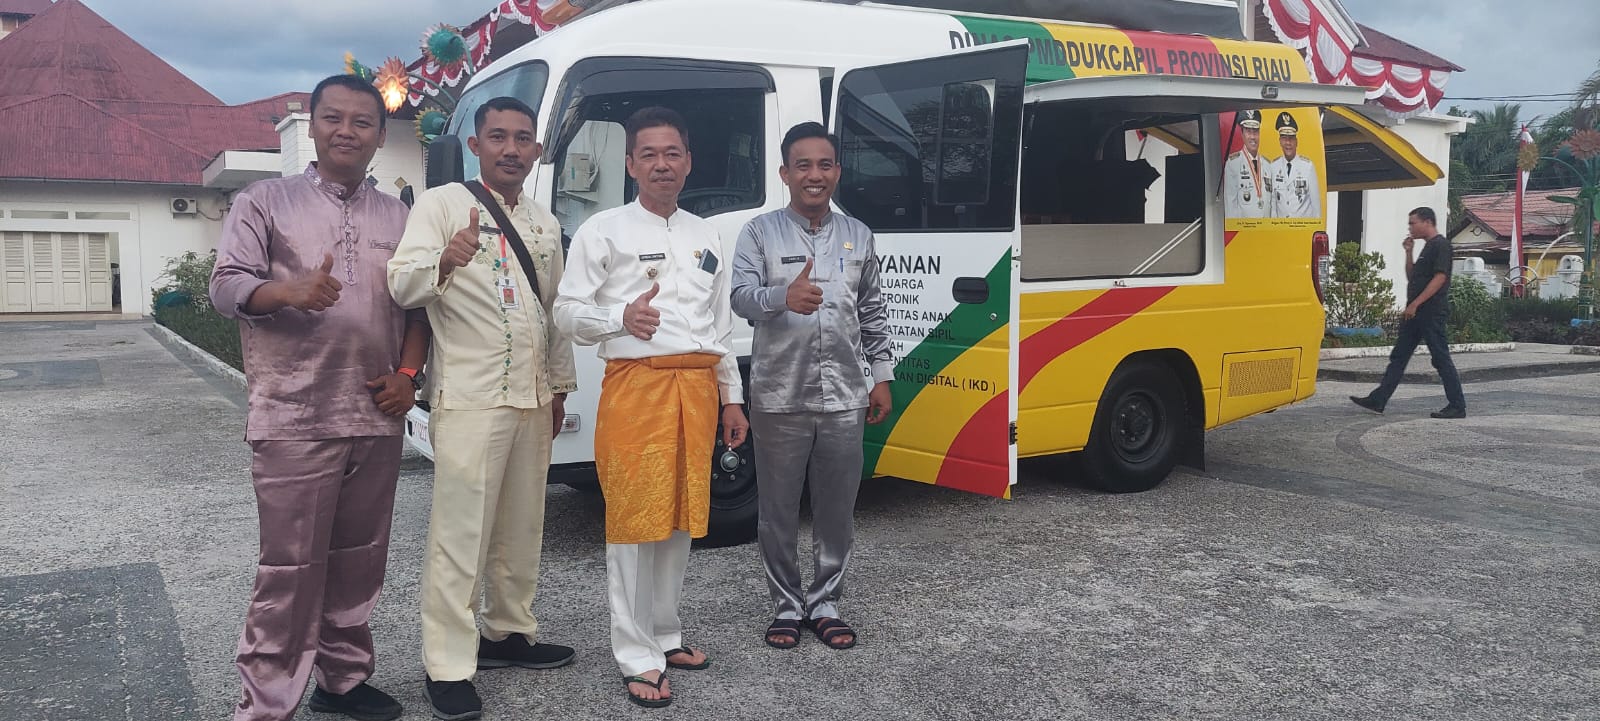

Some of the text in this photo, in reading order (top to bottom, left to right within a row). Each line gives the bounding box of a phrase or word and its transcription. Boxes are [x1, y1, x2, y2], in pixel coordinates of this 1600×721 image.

[1167, 50, 1248, 77] PROVINSI
[1252, 56, 1291, 82] RIAU
[876, 255, 940, 274] YANAN
[881, 278, 924, 289] LUARGA
[882, 293, 919, 304] TRONIK
[885, 309, 952, 323] NTITAS ANAK
[888, 325, 956, 340] ATATAN SIPIL
[917, 373, 959, 388] DIGITAL
